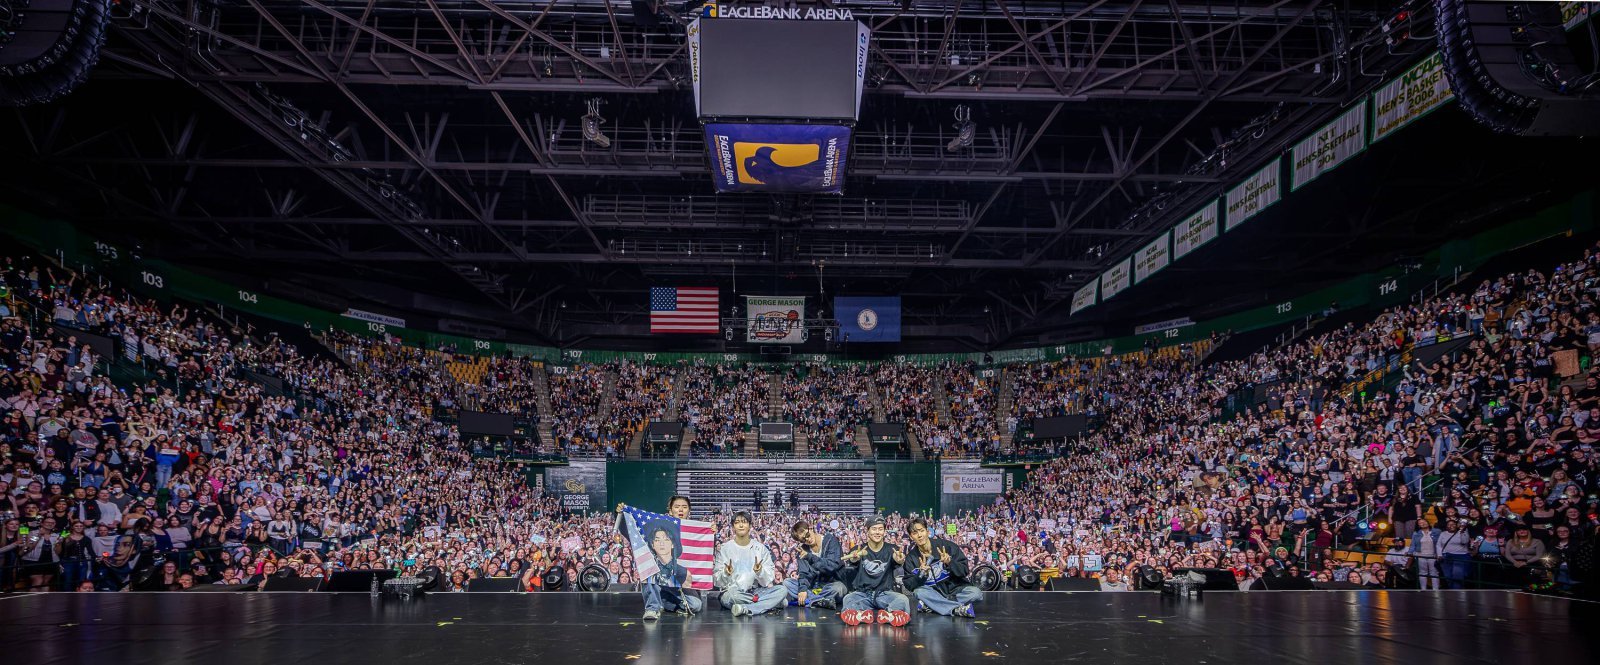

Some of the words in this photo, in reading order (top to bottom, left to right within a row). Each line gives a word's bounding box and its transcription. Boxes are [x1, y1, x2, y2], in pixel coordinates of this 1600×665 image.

[718, 5, 801, 19] EAGLEBANK
[804, 7, 854, 20] ARENA
[1408, 87, 1434, 108] 2006
[141, 271, 163, 288] 103
[1379, 280, 1398, 295] 114
[237, 290, 258, 304] 104
[1276, 302, 1292, 313] 113
[367, 322, 386, 333] 105
[1165, 328, 1179, 338] 112
[474, 340, 490, 350] 106
[1055, 346, 1066, 354] 111
[569, 350, 582, 358] 107
[643, 353, 657, 361] 107
